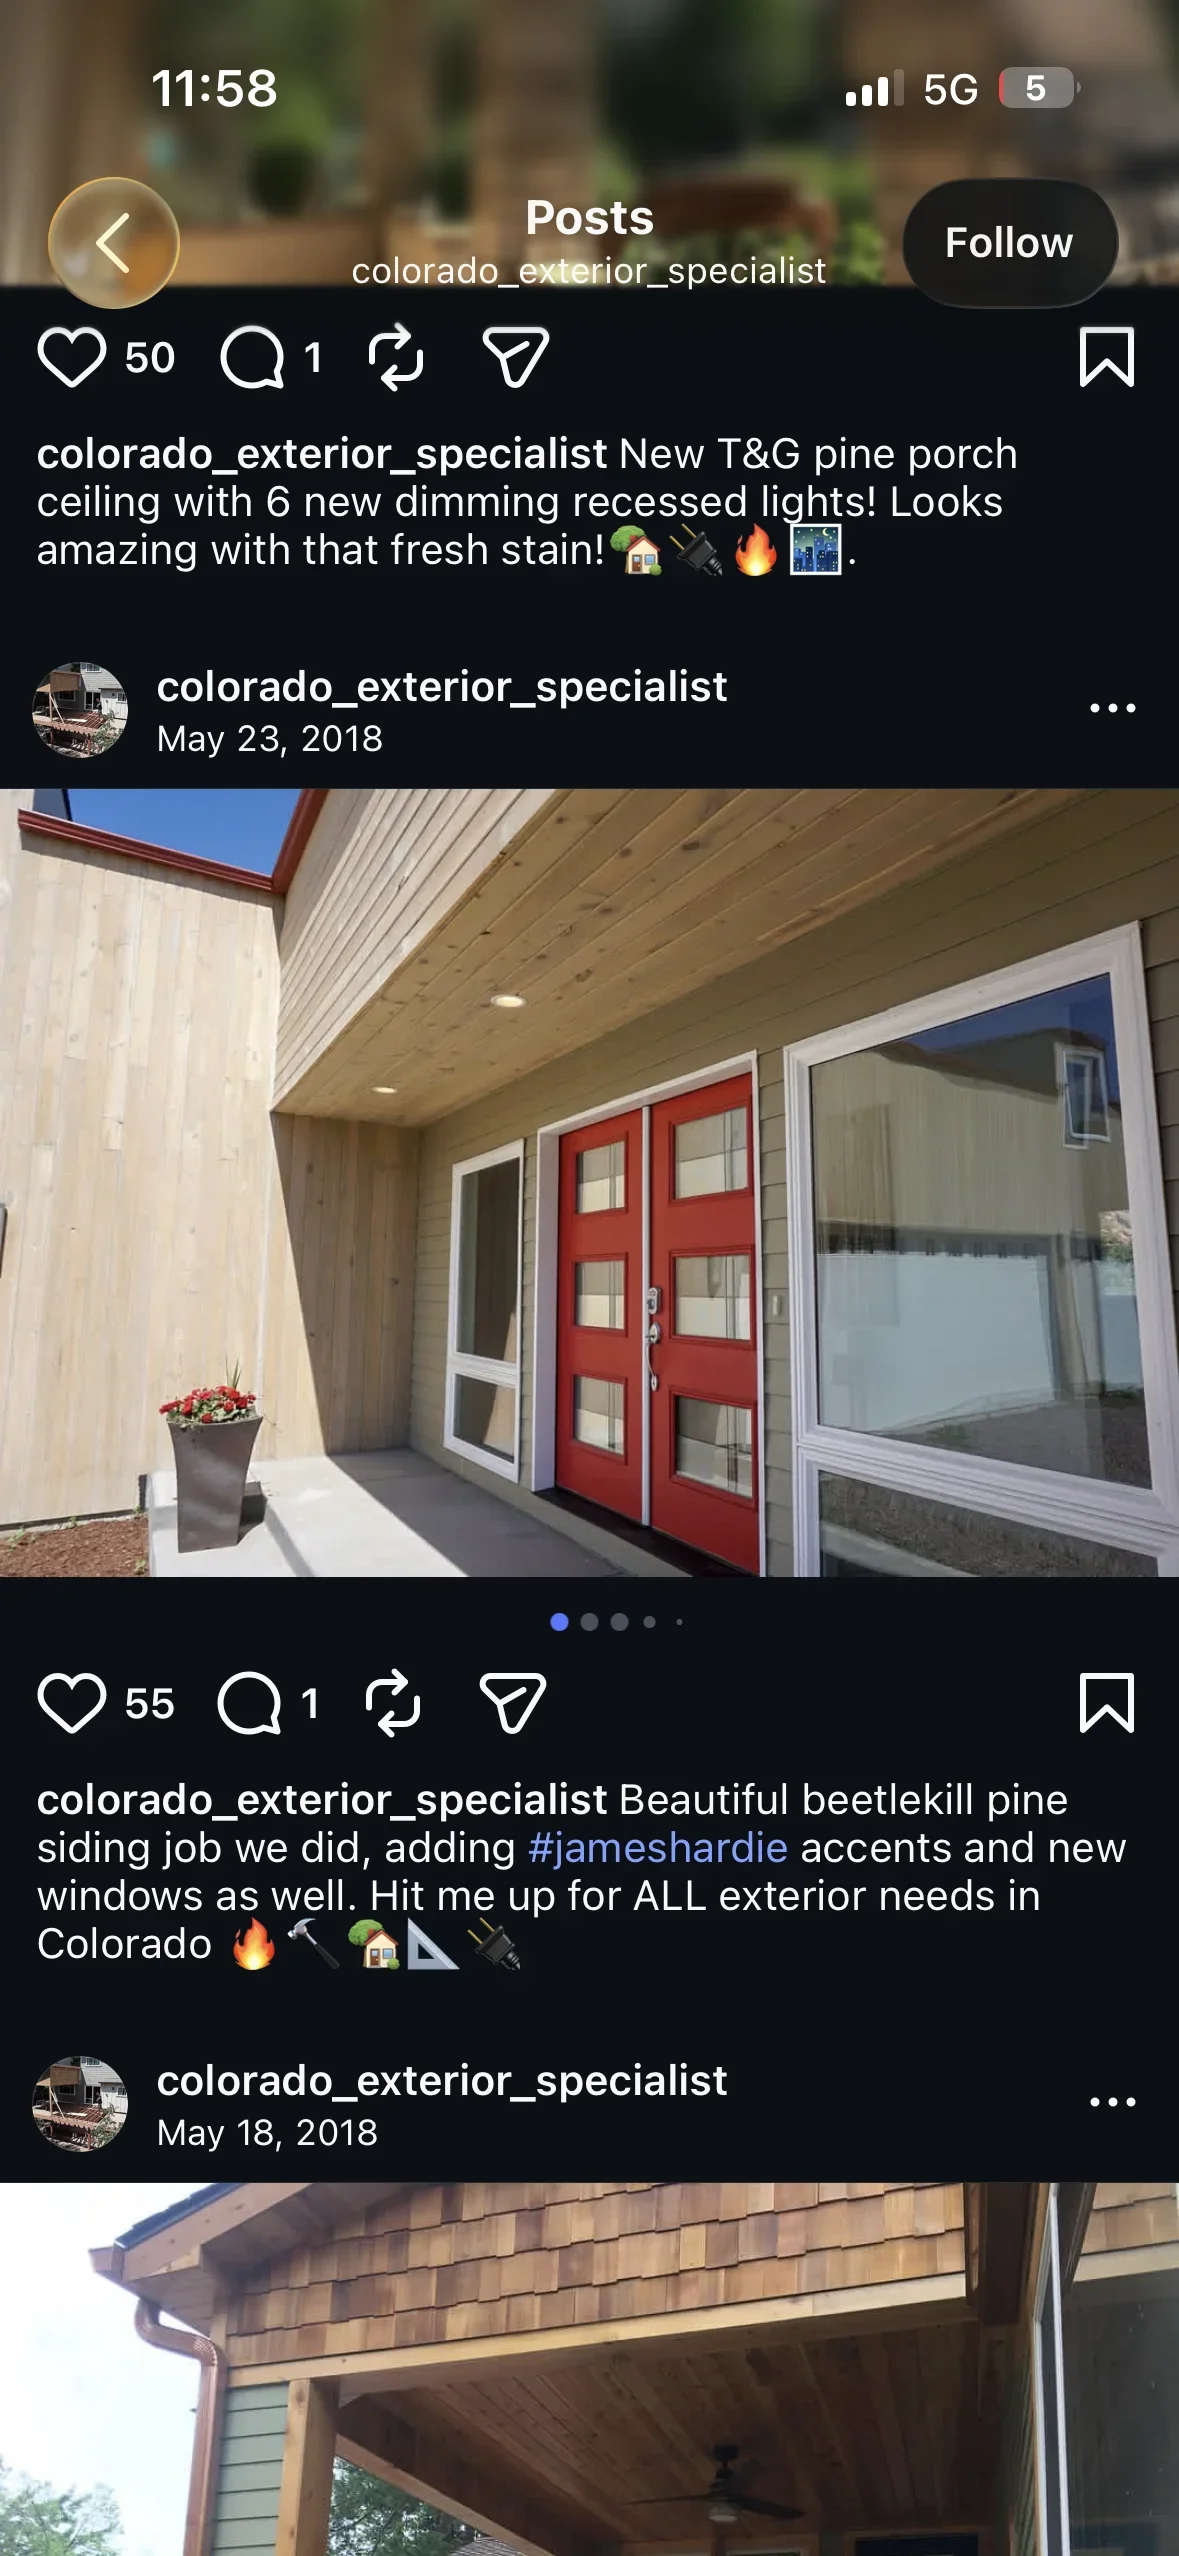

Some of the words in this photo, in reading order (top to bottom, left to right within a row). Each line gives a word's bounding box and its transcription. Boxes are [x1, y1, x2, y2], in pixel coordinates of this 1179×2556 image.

[153, 70, 276, 107] 11:58
[924, 73, 978, 105] 5G
[1026, 75, 1046, 101] 5
[527, 200, 654, 235] Posts
[946, 225, 1074, 258] Follow
[352, 256, 826, 290] colorado_exterior_specialist
[126, 342, 175, 373] 50
[306, 342, 320, 372] 1
[38, 436, 607, 476] colorado_exterior_specialist
[622, 438, 704, 469] New
[718, 438, 799, 469] T&G
[816, 437, 894, 476] pine
[910, 437, 1016, 476] porch
[38, 485, 158, 524] ceiling
[174, 485, 251, 516] with
[268, 486, 289, 517] 6
[306, 493, 381, 516] new
[396, 485, 557, 524] dimming
[575, 485, 746, 517] recessed
[763, 485, 875, 524] lights!
[893, 485, 1002, 516] Looks
[38, 533, 195, 572] amazing
[211, 533, 289, 564] with
[303, 533, 377, 564] that
[391, 533, 487, 564] fresh
[502, 533, 603, 565] stain!
[158, 669, 727, 709] colorado_exterior_specialist
[159, 726, 224, 758] May
[239, 725, 286, 758] 23,
[303, 725, 382, 753] 2018
[126, 1688, 175, 1719] 55
[303, 1688, 317, 1718] 1
[38, 1782, 607, 1822] colorado_exterior_specialist
[622, 1783, 786, 1814] Beautiful
[804, 1783, 971, 1814] beetlekill
[989, 1783, 1067, 1822] pine
[38, 1831, 148, 1870] siding
[162, 1831, 221, 1870] job
[236, 1839, 287, 1862] we
[302, 1831, 369, 1870] did,
[386, 1831, 513, 1870] adding
[529, 1831, 787, 1870] #jameshardie
[802, 1834, 951, 1862] accents
[965, 1831, 1032, 1862] and
[1050, 1839, 1126, 1862] new
[38, 1879, 202, 1910] windows
[217, 1887, 258, 1910] as
[272, 1879, 356, 1910] well.
[372, 1879, 424, 1910] Hit
[439, 1887, 494, 1910] me
[510, 1887, 554, 1918] up
[568, 1879, 621, 1910] for
[634, 1880, 706, 1910] ALL
[720, 1879, 866, 1910] exterior
[881, 1879, 994, 1910] needs
[1010, 1879, 1039, 1910] in
[38, 1927, 212, 1959] Colorado
[158, 2063, 727, 2103] colorado_exterior_specialist
[159, 2120, 224, 2152] May
[238, 2119, 281, 2152] 18,
[298, 2119, 377, 2147] 2018
